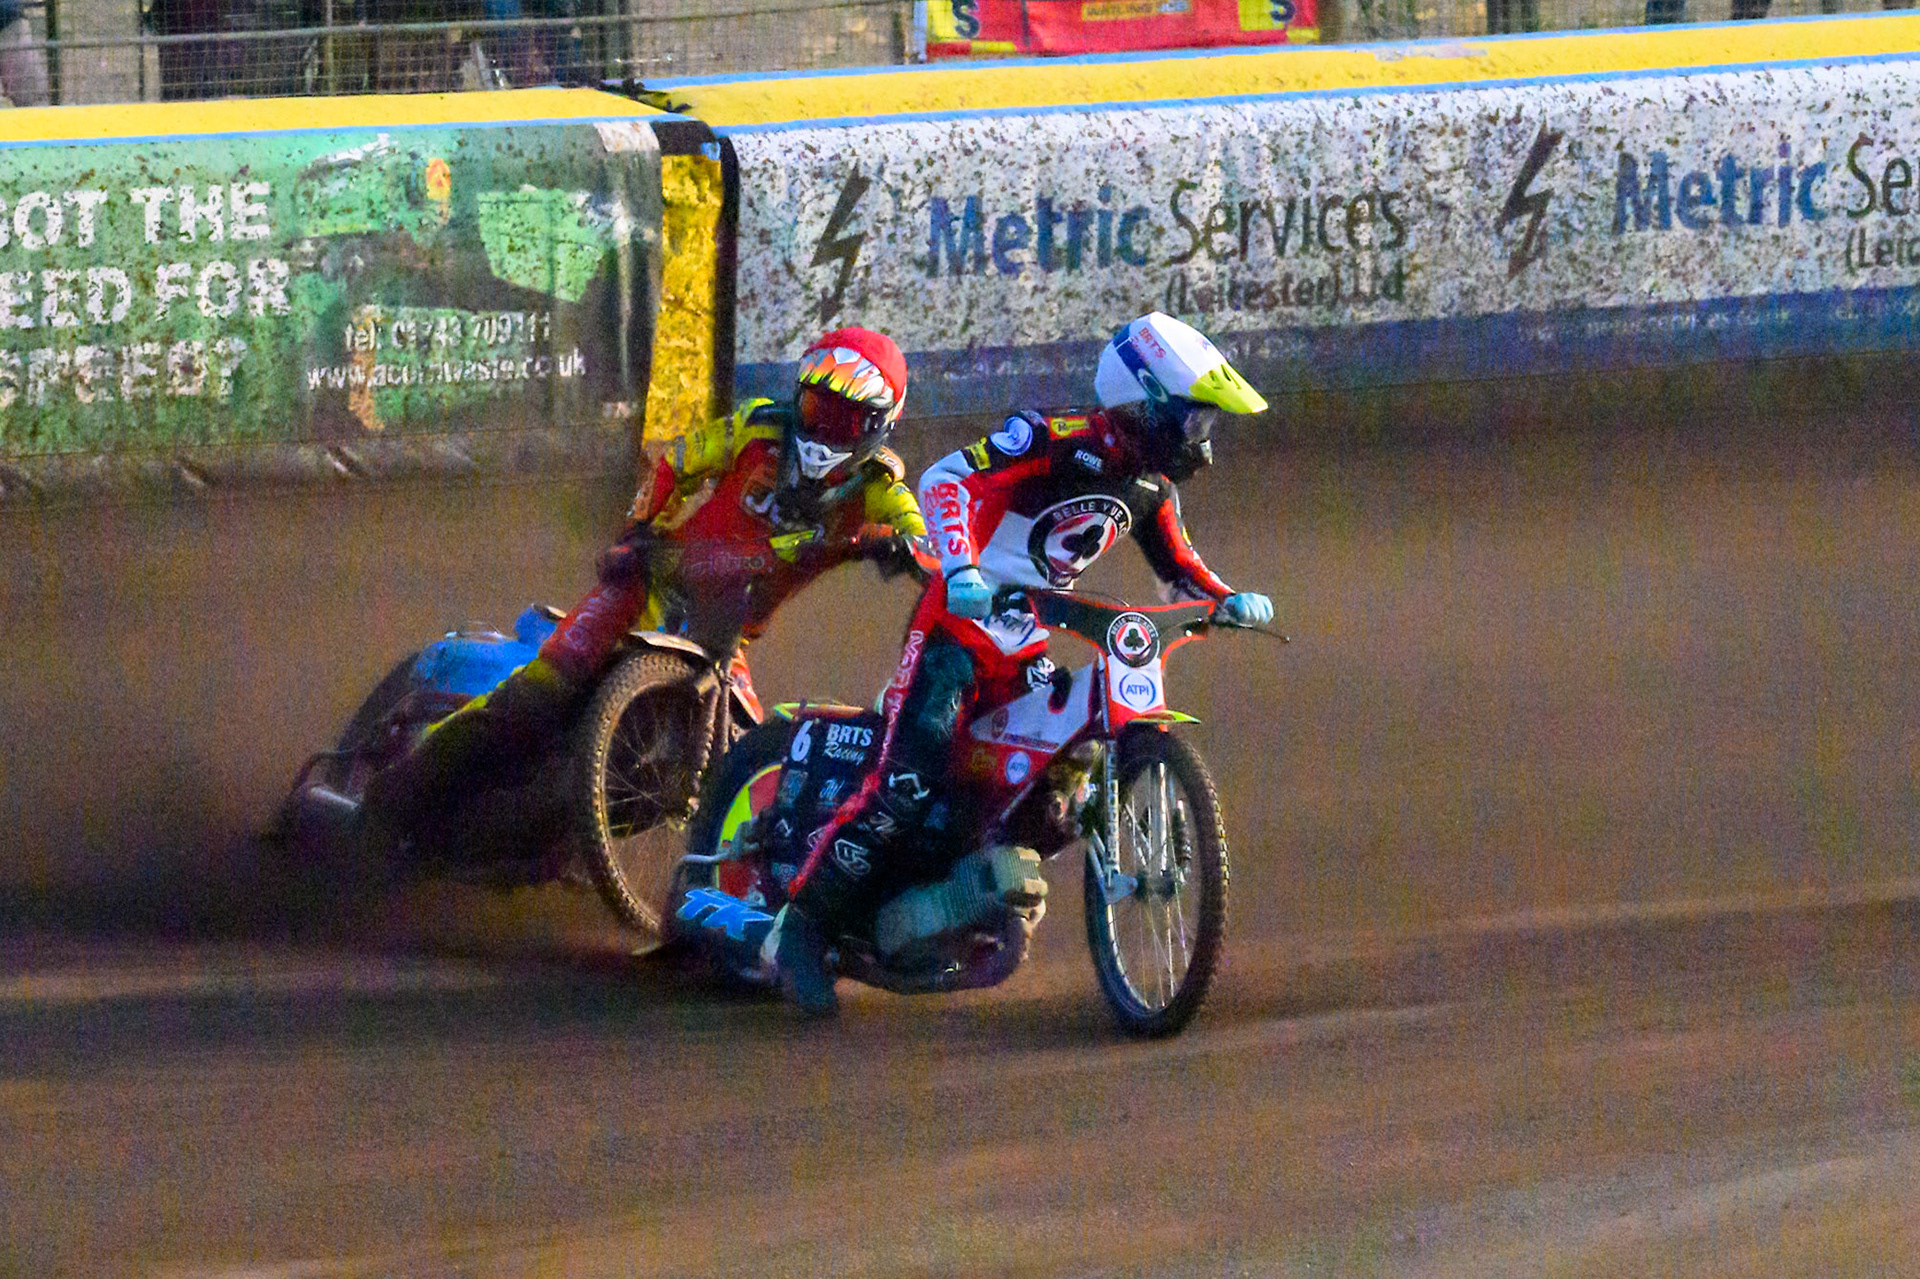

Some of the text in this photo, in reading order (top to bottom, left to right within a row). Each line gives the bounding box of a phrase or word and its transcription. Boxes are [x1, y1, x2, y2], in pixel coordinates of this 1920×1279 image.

[1613, 131, 1920, 235] Metric Se
[0, 181, 271, 250] OT THE
[926, 177, 1404, 277] Metric Services
[154, 258, 292, 321] FOR
[938, 482, 970, 556] BRTS
[1053, 501, 1096, 523] BELLE
[1125, 684, 1151, 696] ATPI
[790, 720, 813, 762] 6
[824, 741, 865, 766] Racing
[826, 723, 873, 747] BRTS
